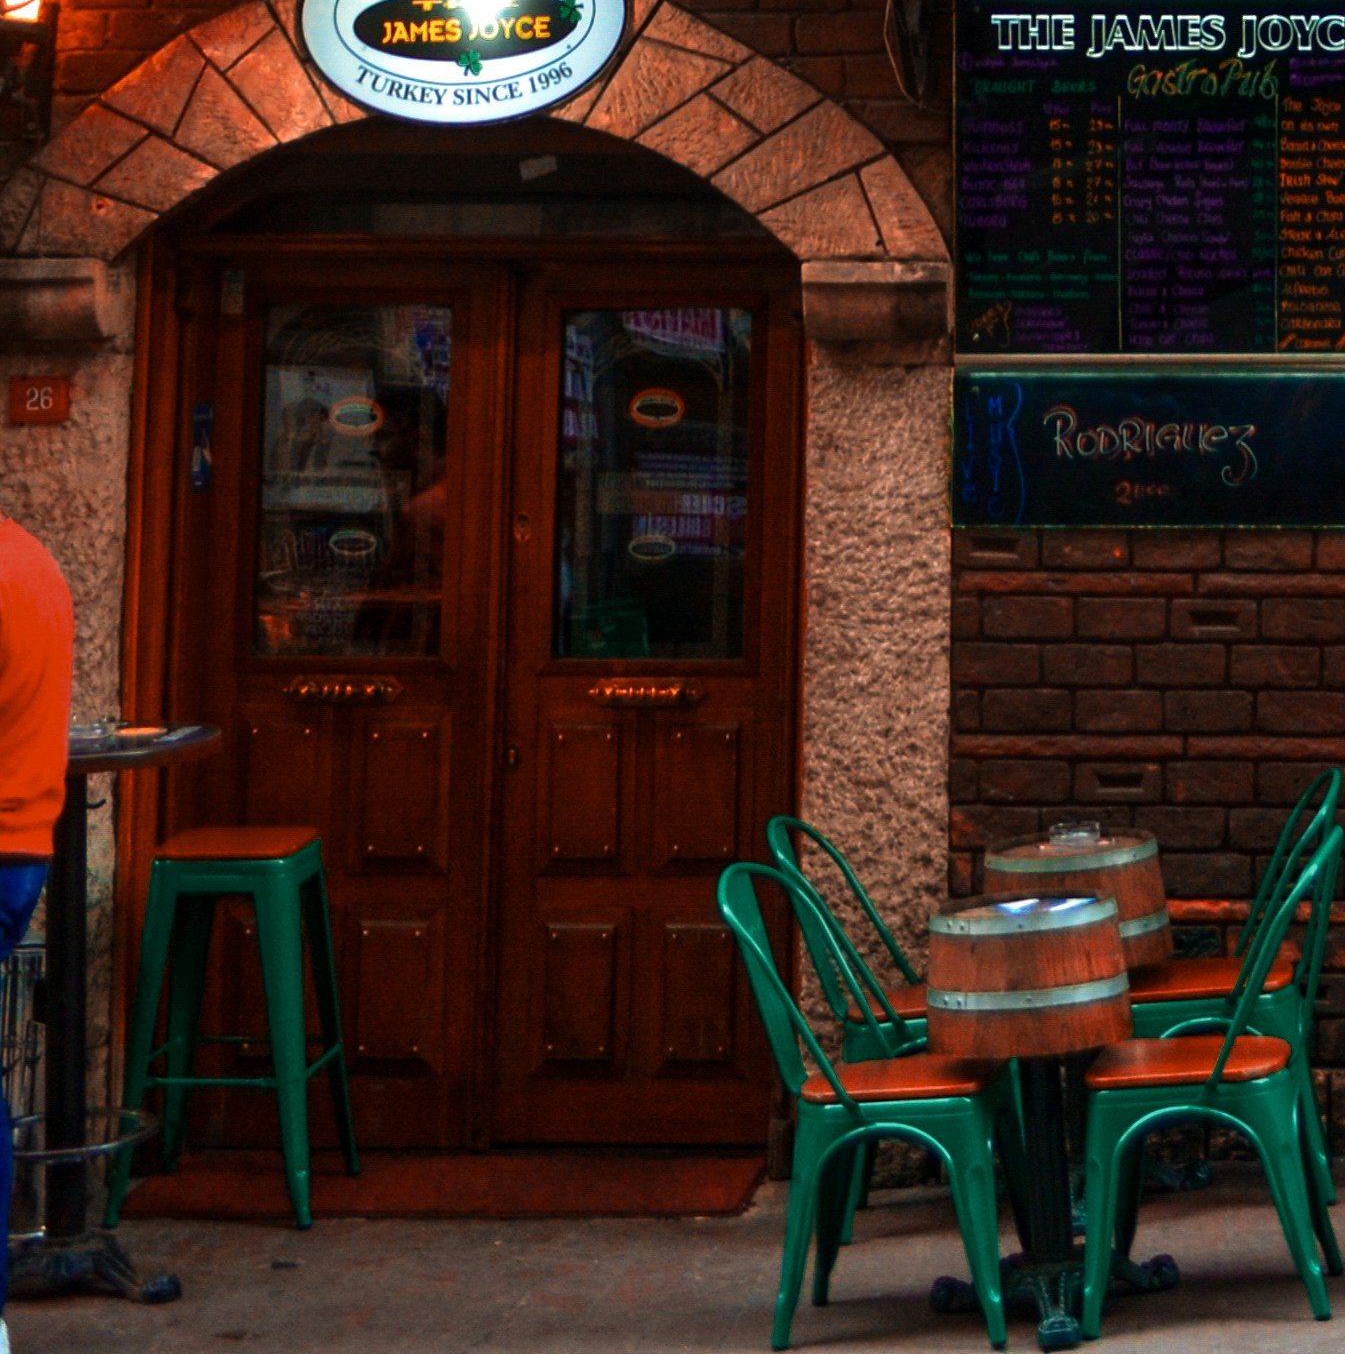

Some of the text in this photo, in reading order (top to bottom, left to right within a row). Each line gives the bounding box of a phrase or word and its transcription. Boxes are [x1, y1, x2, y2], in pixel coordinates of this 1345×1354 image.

[382, 15, 551, 45] JAMES JOYCE
[991, 13, 1075, 51] THE
[1086, 13, 1227, 59] JAMES
[355, 61, 574, 106] TURKEY SINCE 1996
[26, 386, 54, 411] 26
